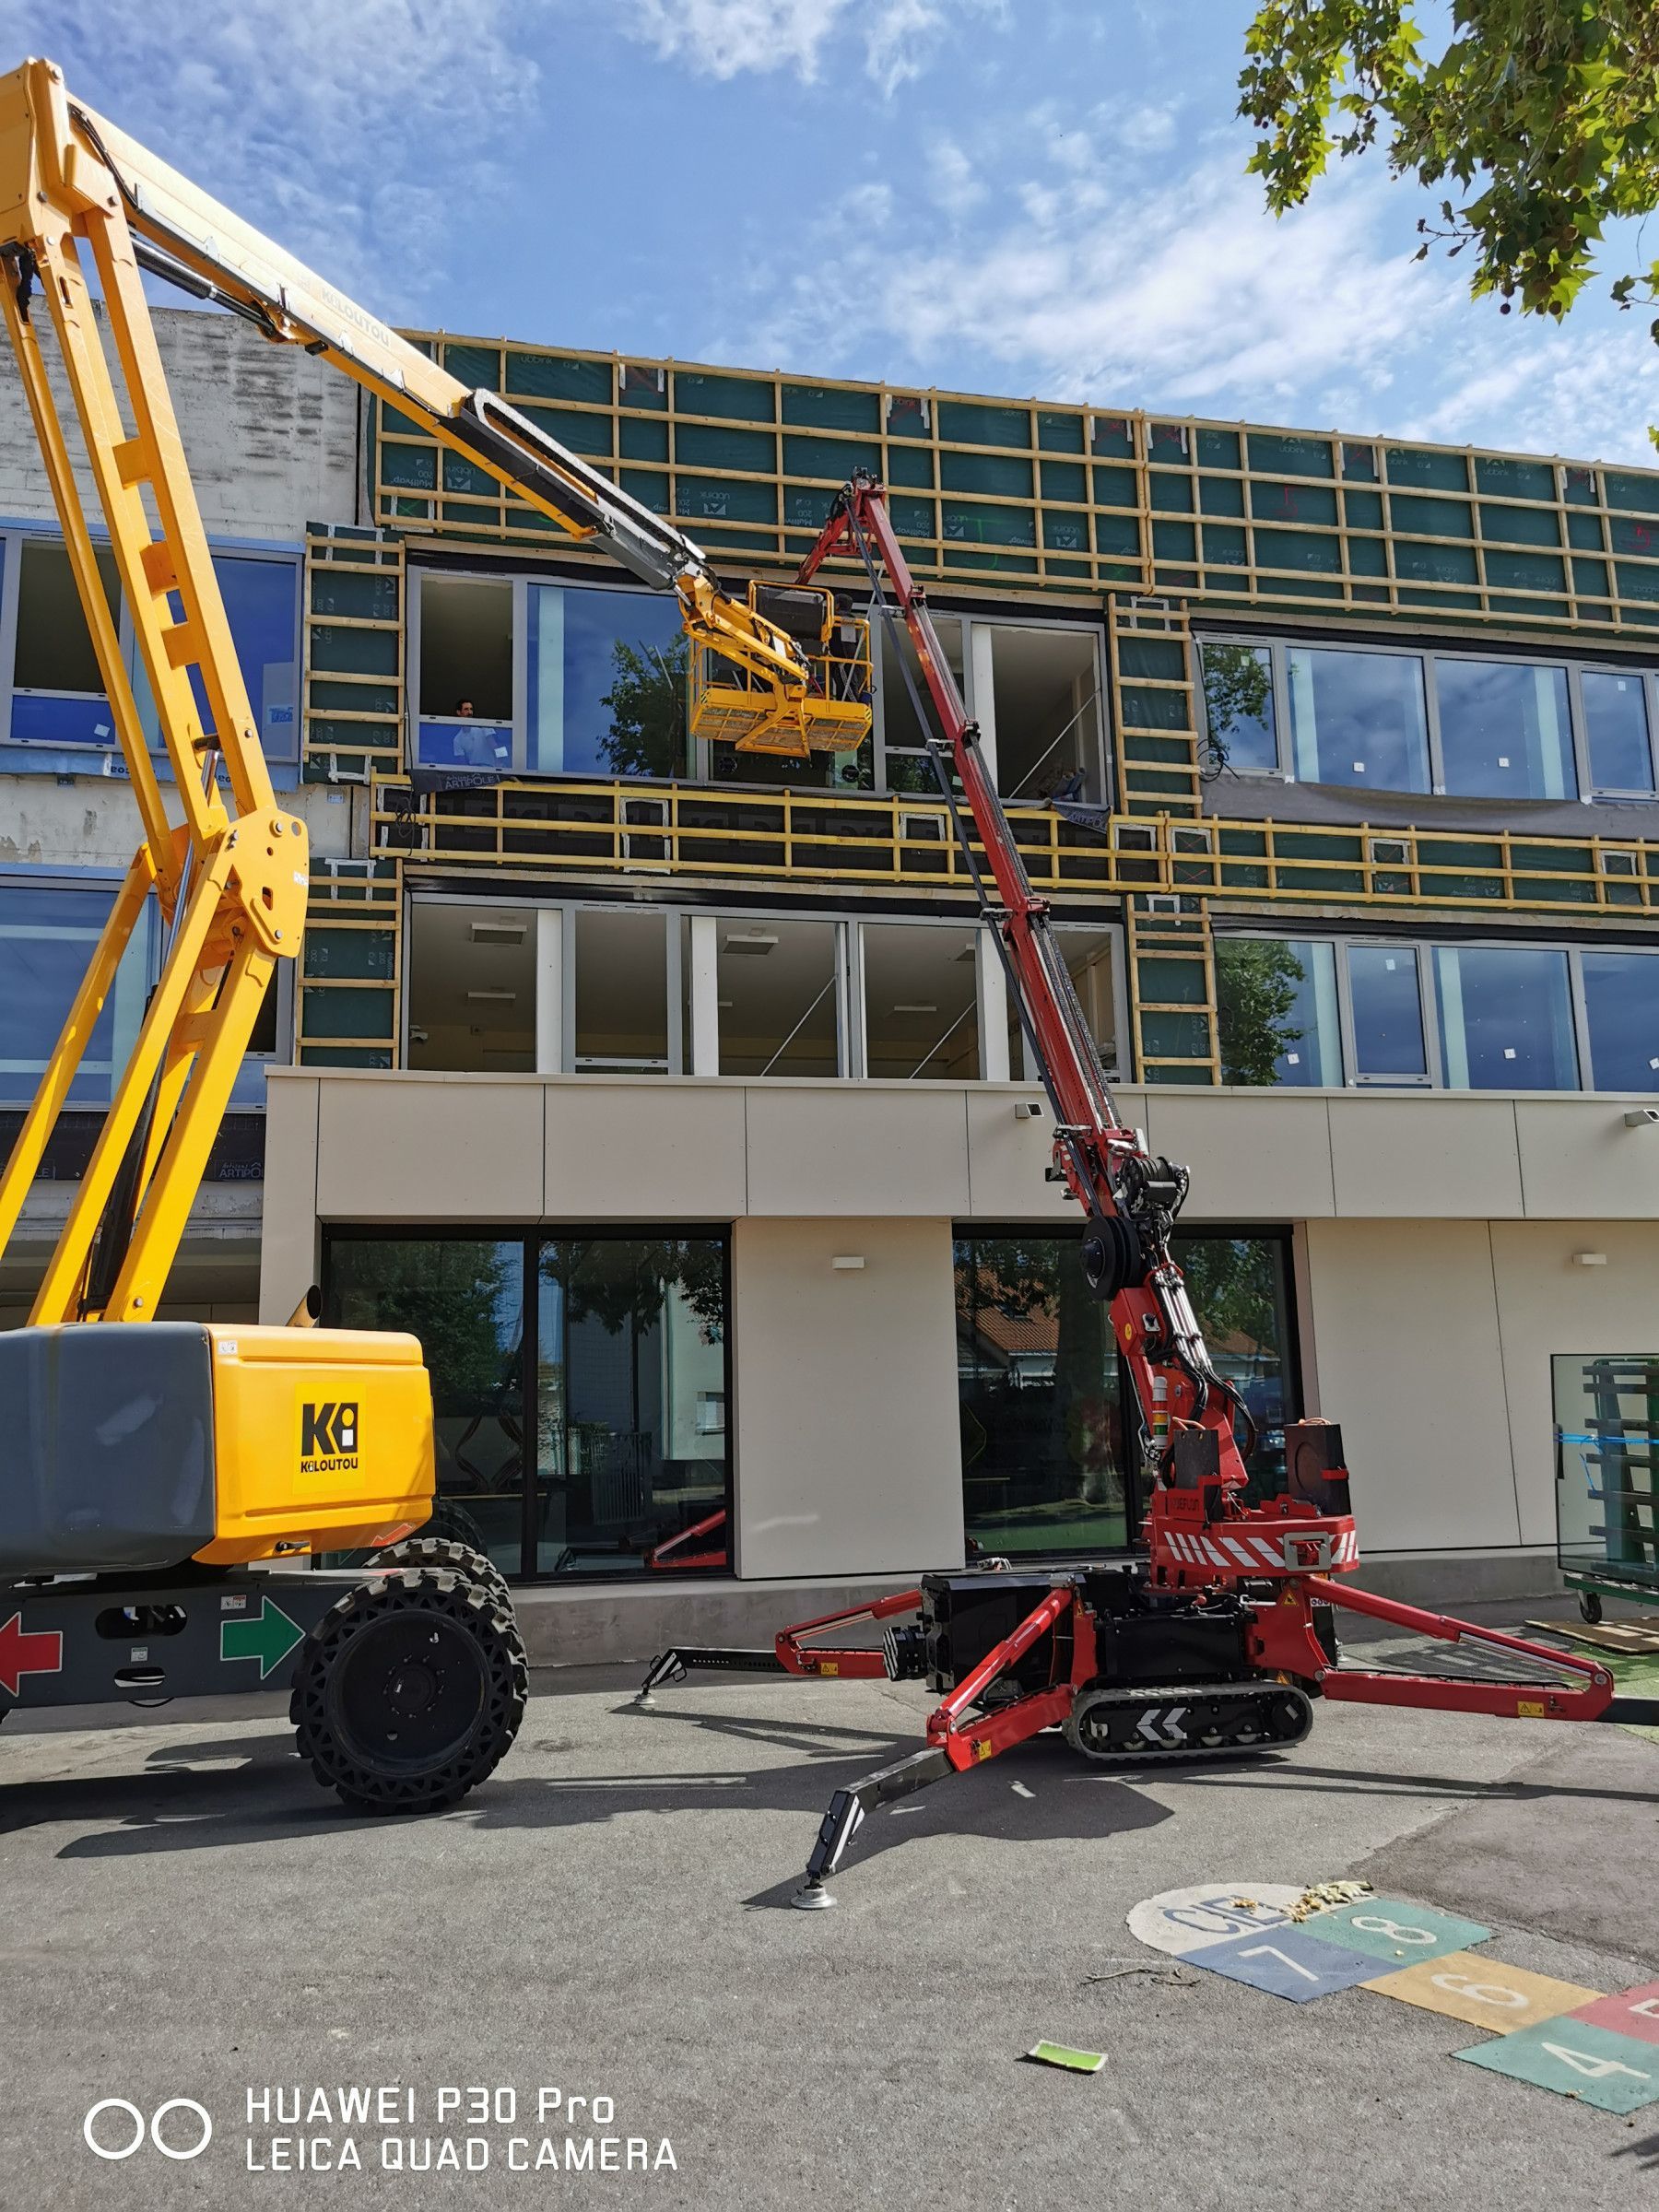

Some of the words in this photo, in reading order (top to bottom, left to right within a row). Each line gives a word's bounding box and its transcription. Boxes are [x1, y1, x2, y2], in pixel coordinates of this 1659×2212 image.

[1350, 1915, 1438, 1945] 8
[1237, 1945, 1320, 1982] 7
[1430, 1973, 1529, 2007] 6
[1541, 2041, 1652, 2078] 4
